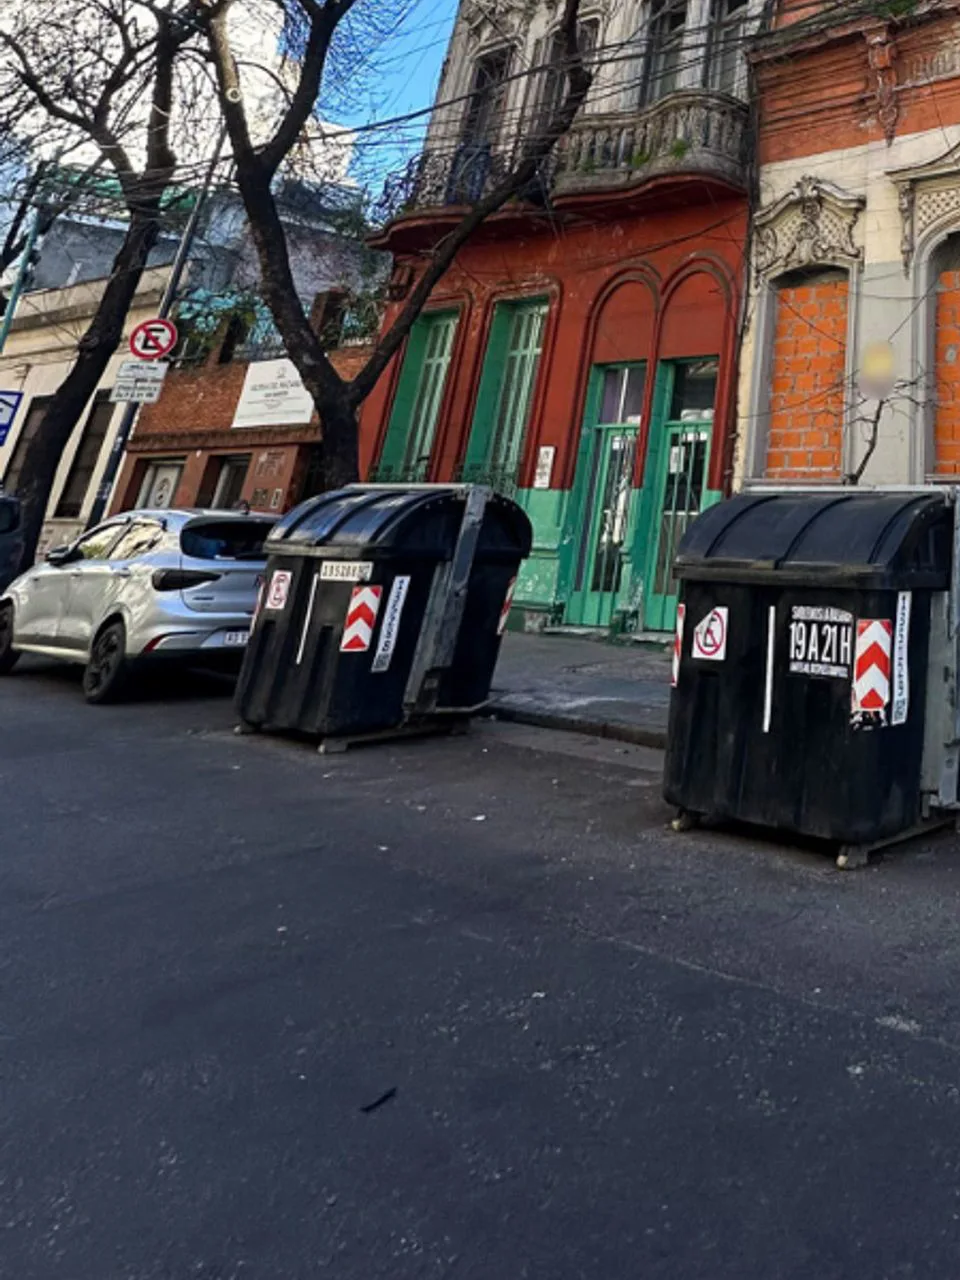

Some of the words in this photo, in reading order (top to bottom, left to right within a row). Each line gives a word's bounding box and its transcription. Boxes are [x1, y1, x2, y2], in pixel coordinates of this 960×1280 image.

[790, 621, 806, 661] 19
[807, 623, 818, 662] A
[821, 624, 837, 663] 21
[840, 625, 852, 665] H
